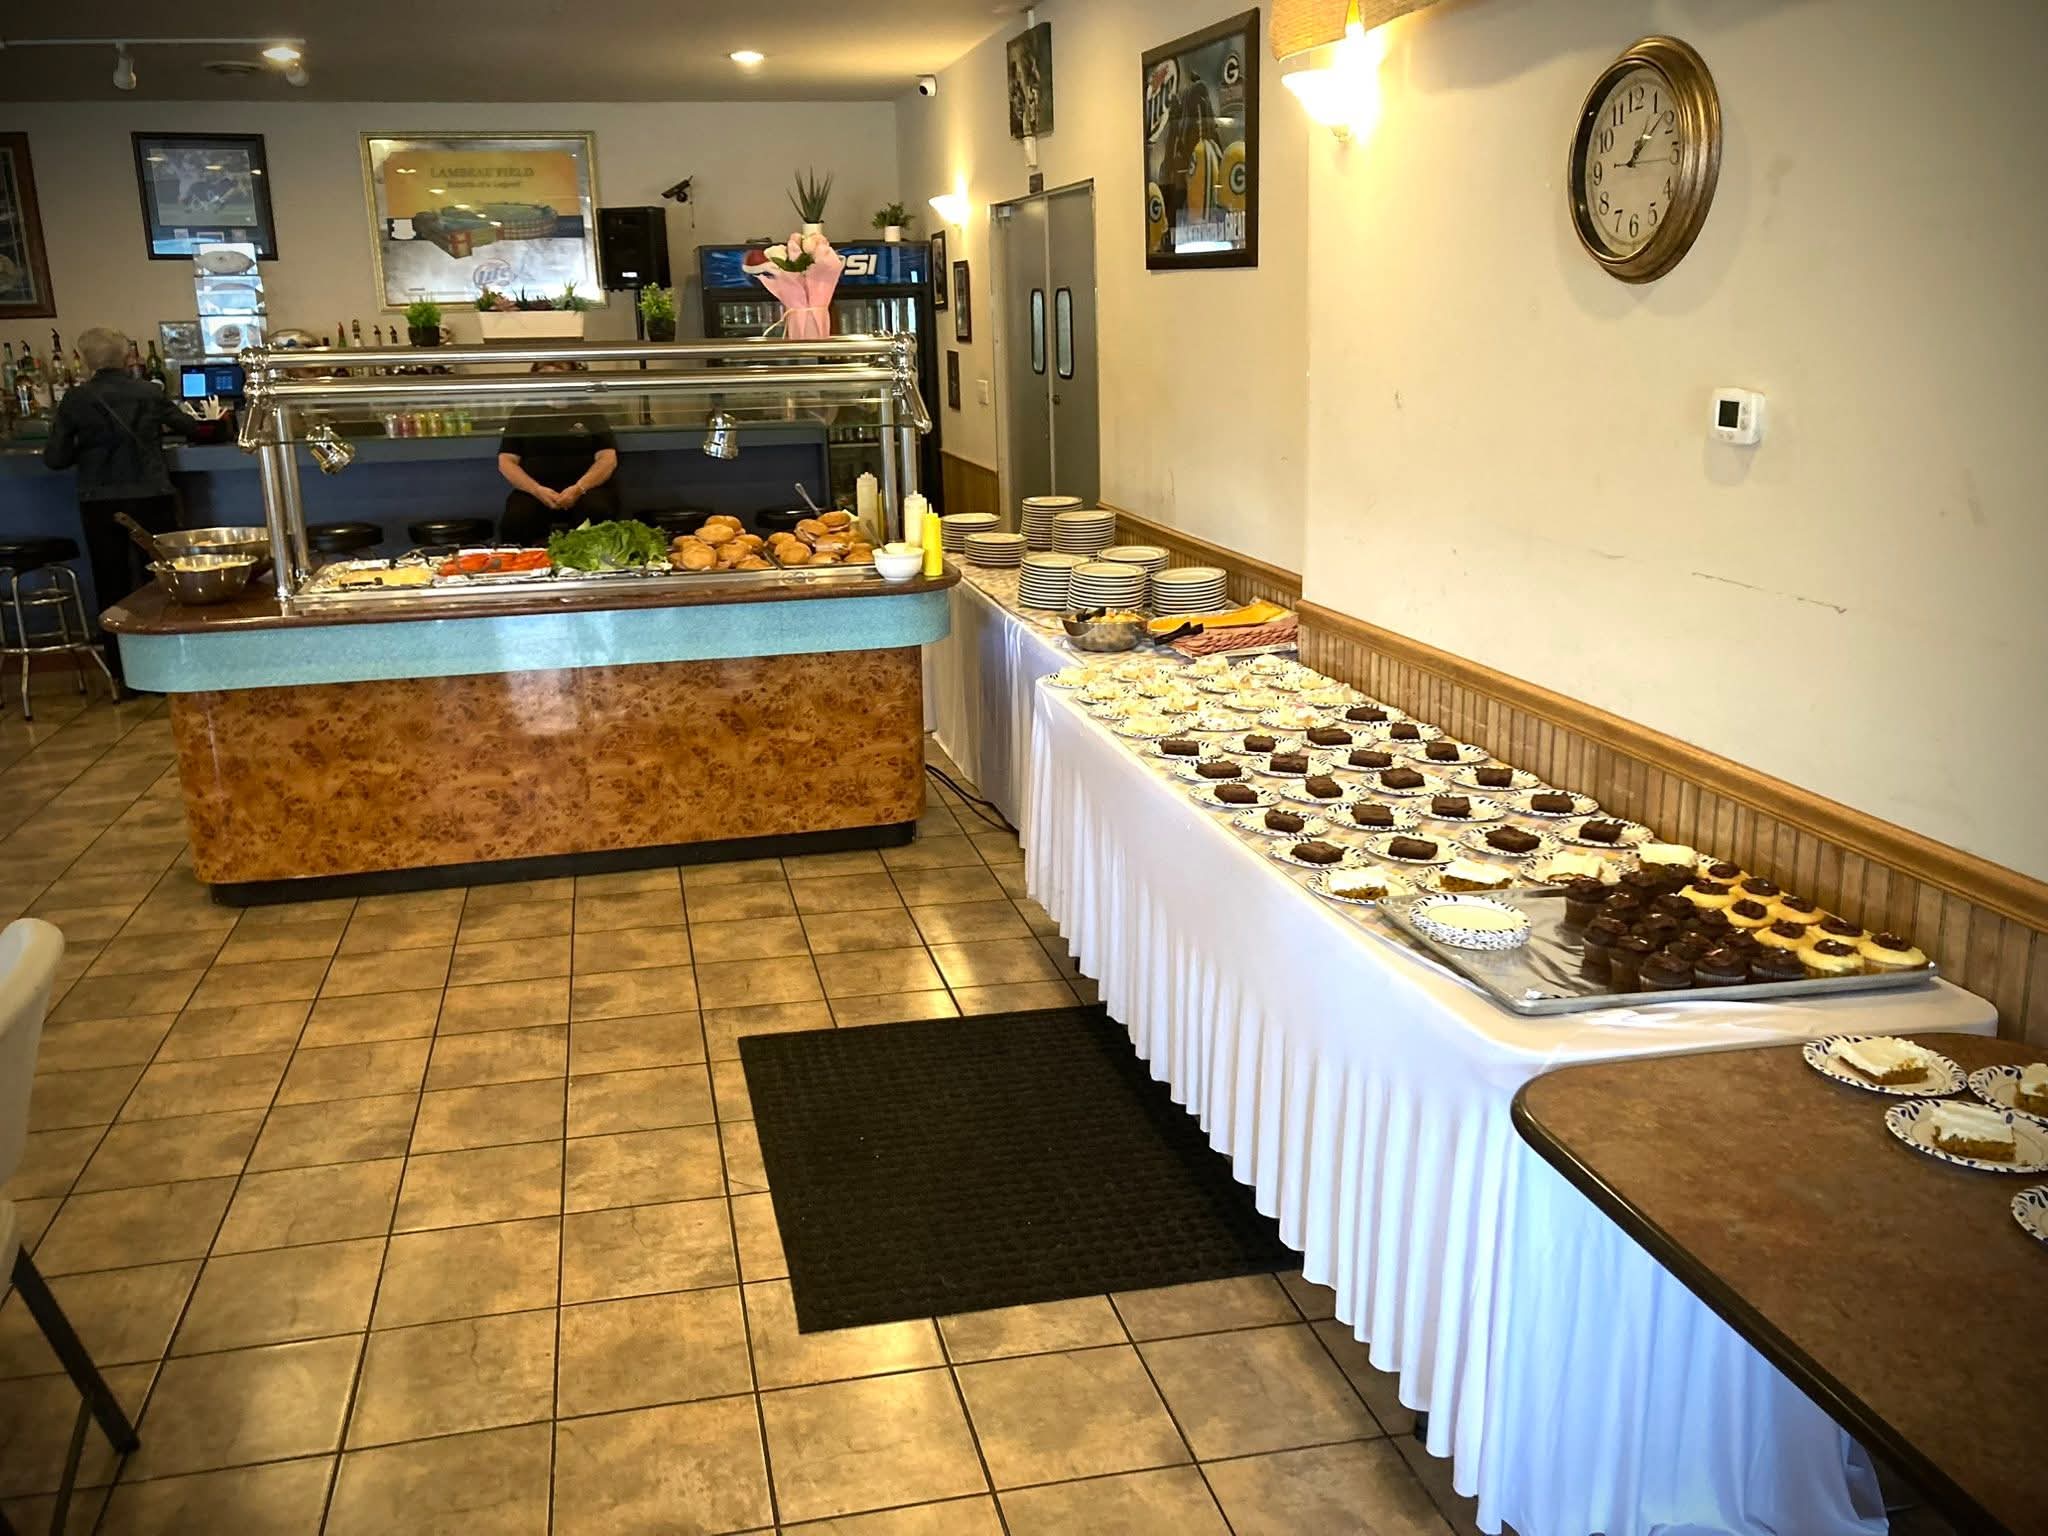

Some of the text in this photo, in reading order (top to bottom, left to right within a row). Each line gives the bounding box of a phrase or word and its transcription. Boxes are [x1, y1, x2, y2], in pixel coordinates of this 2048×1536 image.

[1224, 57, 1239, 84] G
[1629, 86, 1644, 113] 12
[1653, 90, 1658, 114] 1
[1612, 101, 1624, 127] 11
[1664, 110, 1675, 135] 2
[1600, 127, 1614, 154] 10
[1669, 141, 1680, 165] 3
[1593, 161, 1602, 186] 9
[1663, 176, 1673, 200] 4
[1599, 191, 1609, 215] 8
[1648, 202, 1658, 226] 5
[1614, 209, 1623, 233] 7
[1629, 213, 1639, 238] 6
